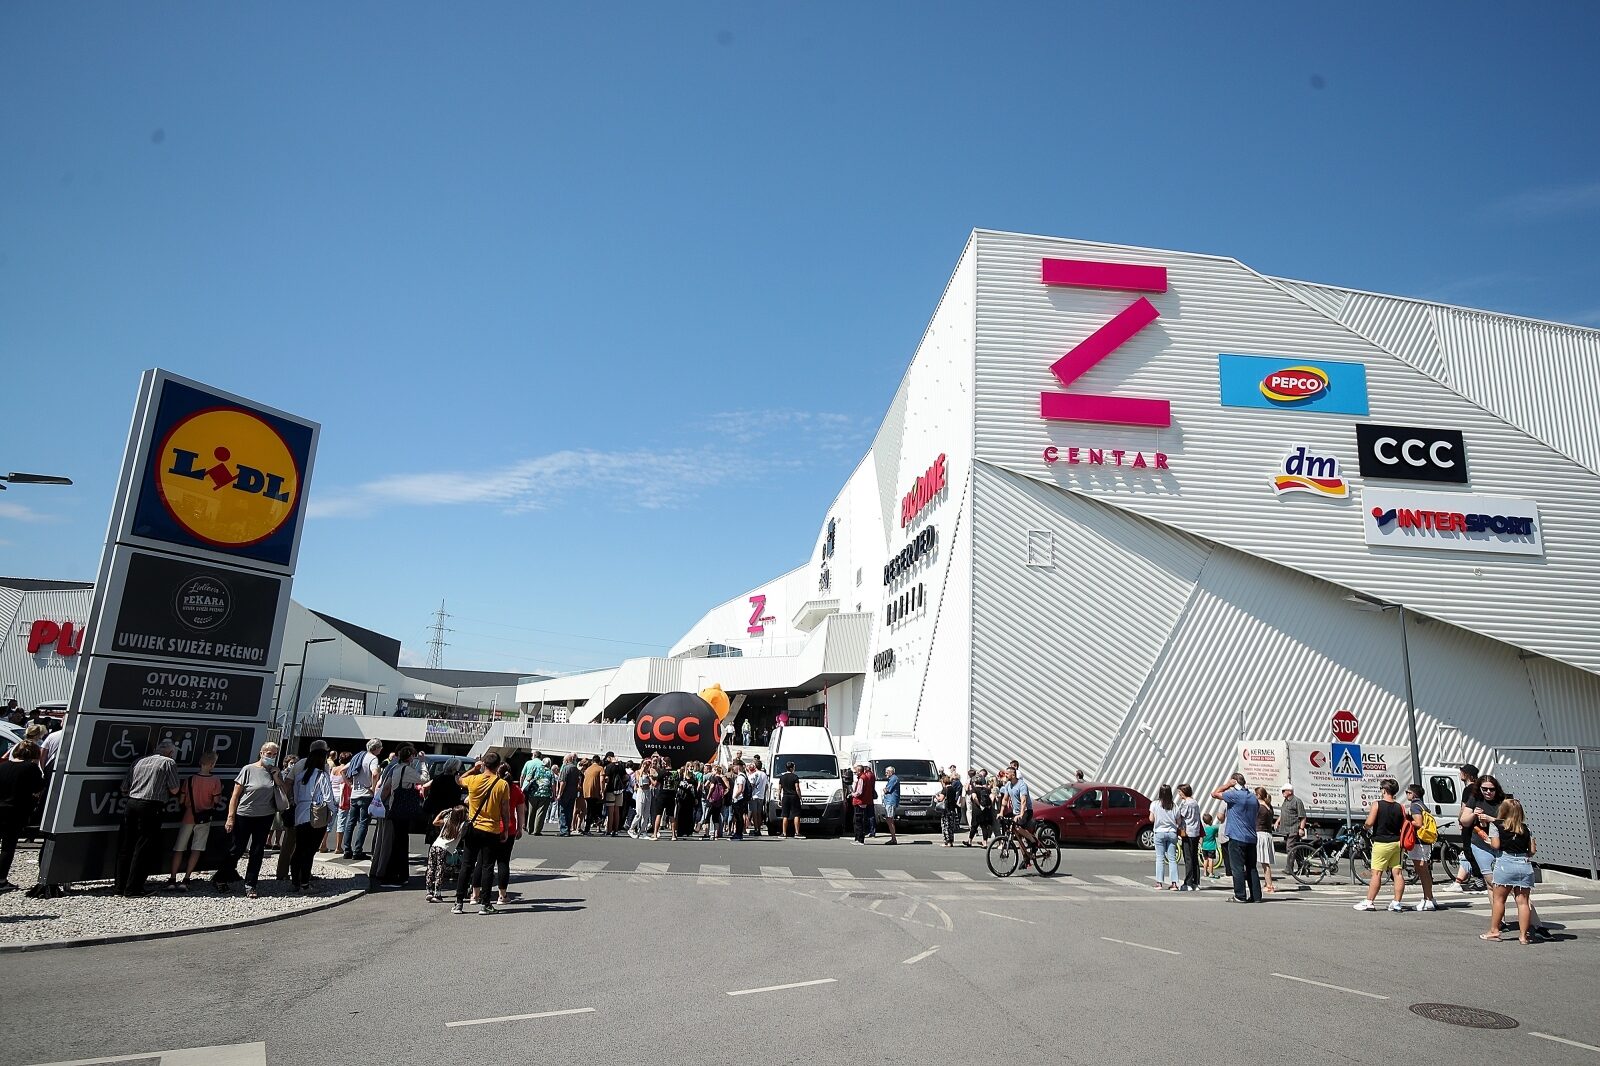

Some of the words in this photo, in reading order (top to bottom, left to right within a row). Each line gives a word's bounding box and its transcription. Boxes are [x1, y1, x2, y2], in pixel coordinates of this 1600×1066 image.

[1271, 376, 1319, 391] PEPCO
[1043, 446, 1169, 470] CENTAR
[1285, 447, 1336, 477] dm
[1374, 437, 1455, 469] CCC
[901, 453, 945, 528] PLODINE
[1397, 508, 1533, 535] INTERSPORT
[884, 525, 935, 586] RESERVED
[183, 595, 225, 606] PEKARA
[118, 632, 166, 650] UVIJEK
[168, 638, 213, 656] SVJEŽE
[215, 643, 265, 661] PEČENO!
[146, 672, 229, 690] OTVORENO
[142, 698, 189, 710] NEDJELJA:
[190, 701, 197, 710] 8
[205, 702, 215, 711] 21
[216, 703, 223, 711] h
[196, 690, 203, 699] 7
[209, 691, 221, 700] 21
[221, 692, 228, 701] h
[636, 714, 700, 743] CCC
[1332, 719, 1358, 734] STOP
